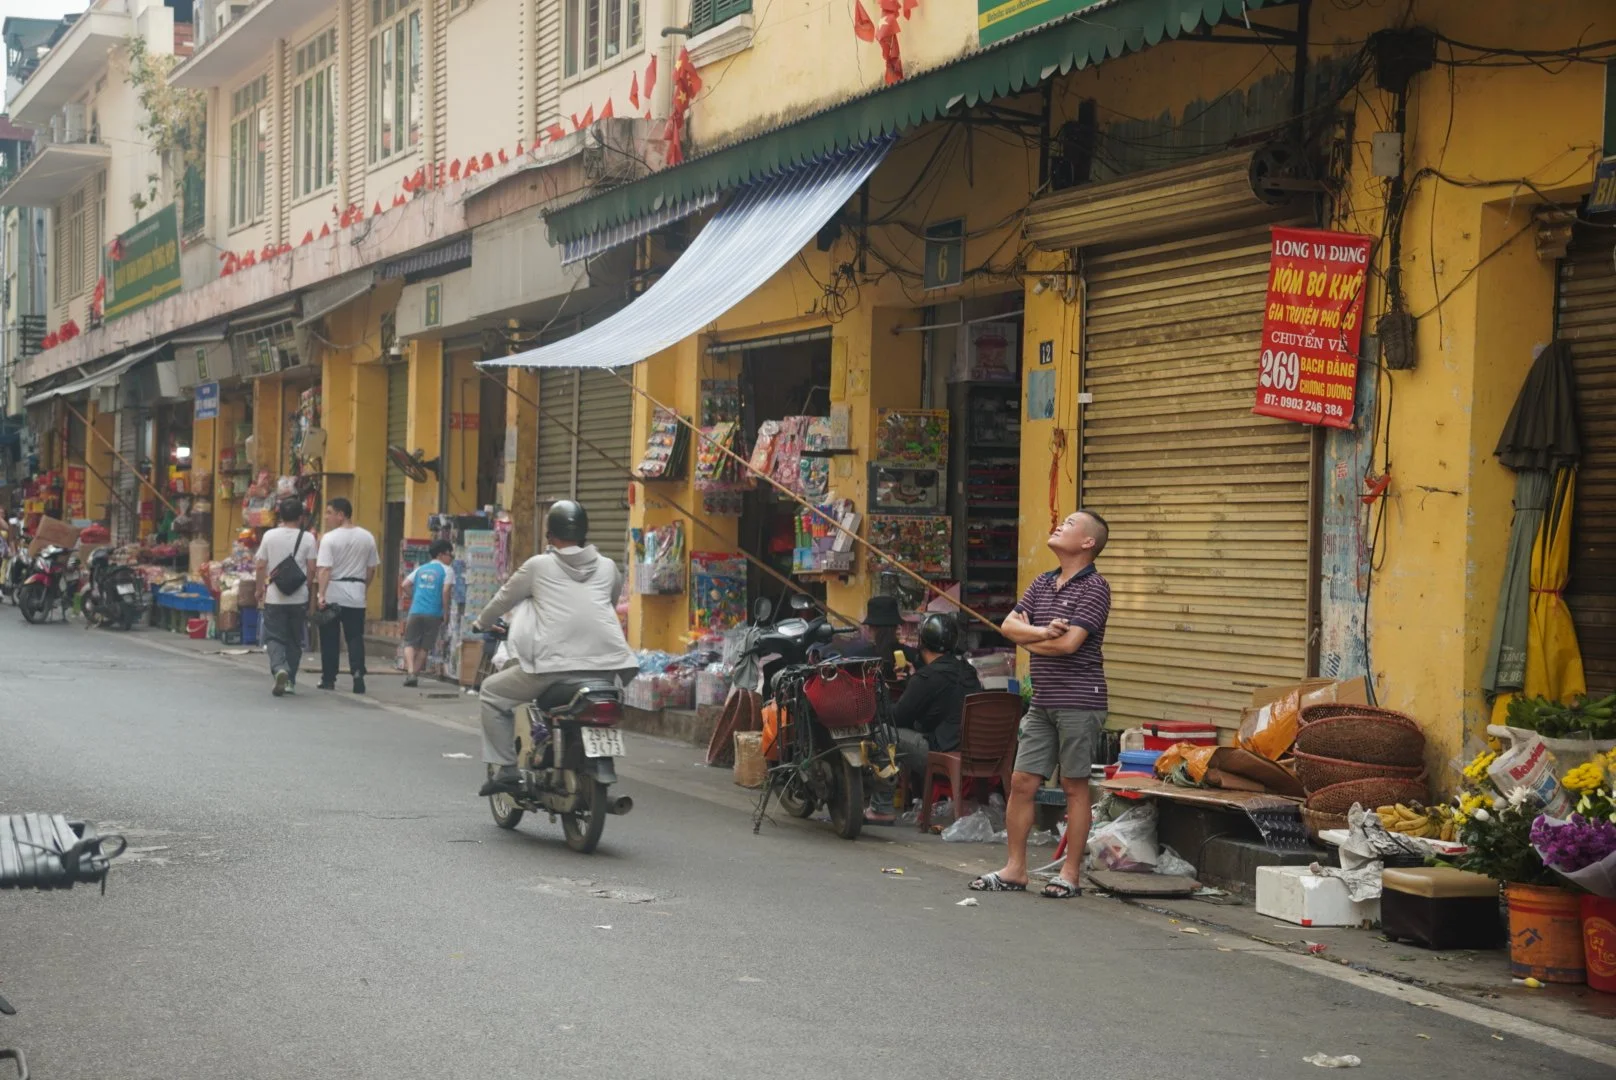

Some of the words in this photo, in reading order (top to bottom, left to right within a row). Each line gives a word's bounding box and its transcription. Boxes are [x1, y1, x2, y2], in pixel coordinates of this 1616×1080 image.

[1276, 240, 1309, 258] LONG
[1314, 244, 1325, 259] VI
[1330, 245, 1365, 263] DUNG
[938, 247, 947, 281] 6
[1272, 263, 1303, 298] NỘM
[1307, 265, 1327, 297] BÒ
[1329, 270, 1363, 300] KHÔ
[1269, 303, 1283, 321] GIA
[1319, 304, 1342, 328] PHỐ
[1342, 305, 1358, 330] CỔ
[1271, 329, 1324, 349] CHUYỂN
[1328, 335, 1348, 353] VỀ
[1042, 345, 1051, 364] 12
[1260, 349, 1300, 392] 269
[1301, 357, 1324, 376] BẠCH
[1327, 355, 1355, 378] ĐẰNG
[1326, 383, 1352, 400] DƯƠNG
[1264, 393, 1278, 405] ĐT:
[1280, 396, 1303, 410] 0903
[1306, 401, 1322, 413] 246
[1325, 404, 1343, 416] 384
